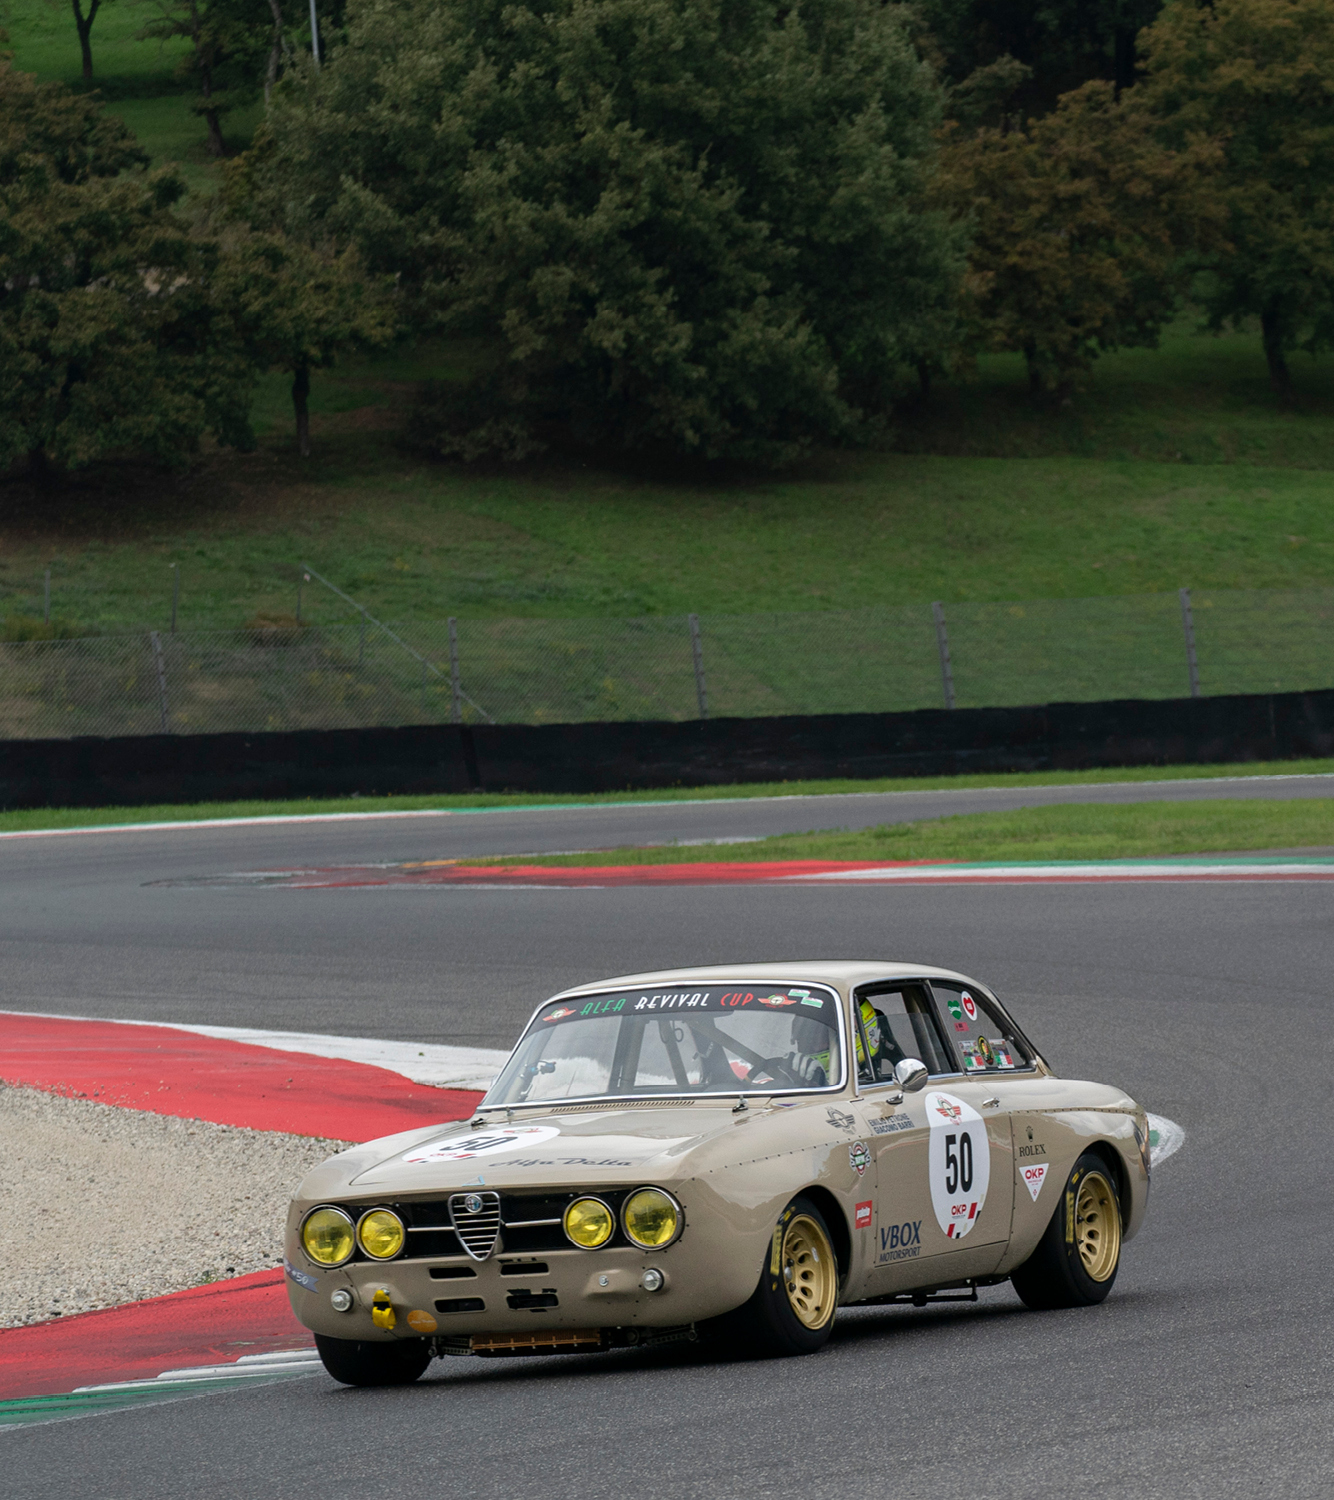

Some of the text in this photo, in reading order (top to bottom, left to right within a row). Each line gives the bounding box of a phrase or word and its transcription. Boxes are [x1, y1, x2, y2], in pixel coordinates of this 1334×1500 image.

[580, 992, 754, 1016] ALFA REVIVAL CUP
[439, 1136, 519, 1151] 50
[1019, 1144, 1047, 1157] ROLEX
[488, 1157, 634, 1168] Alfa Delta
[945, 1131, 973, 1195] 50
[1025, 1167, 1044, 1180] OKP
[951, 1204, 967, 1216] OKP
[880, 1220, 922, 1251] VBOX
[879, 1246, 922, 1263] MOTORSPORT
